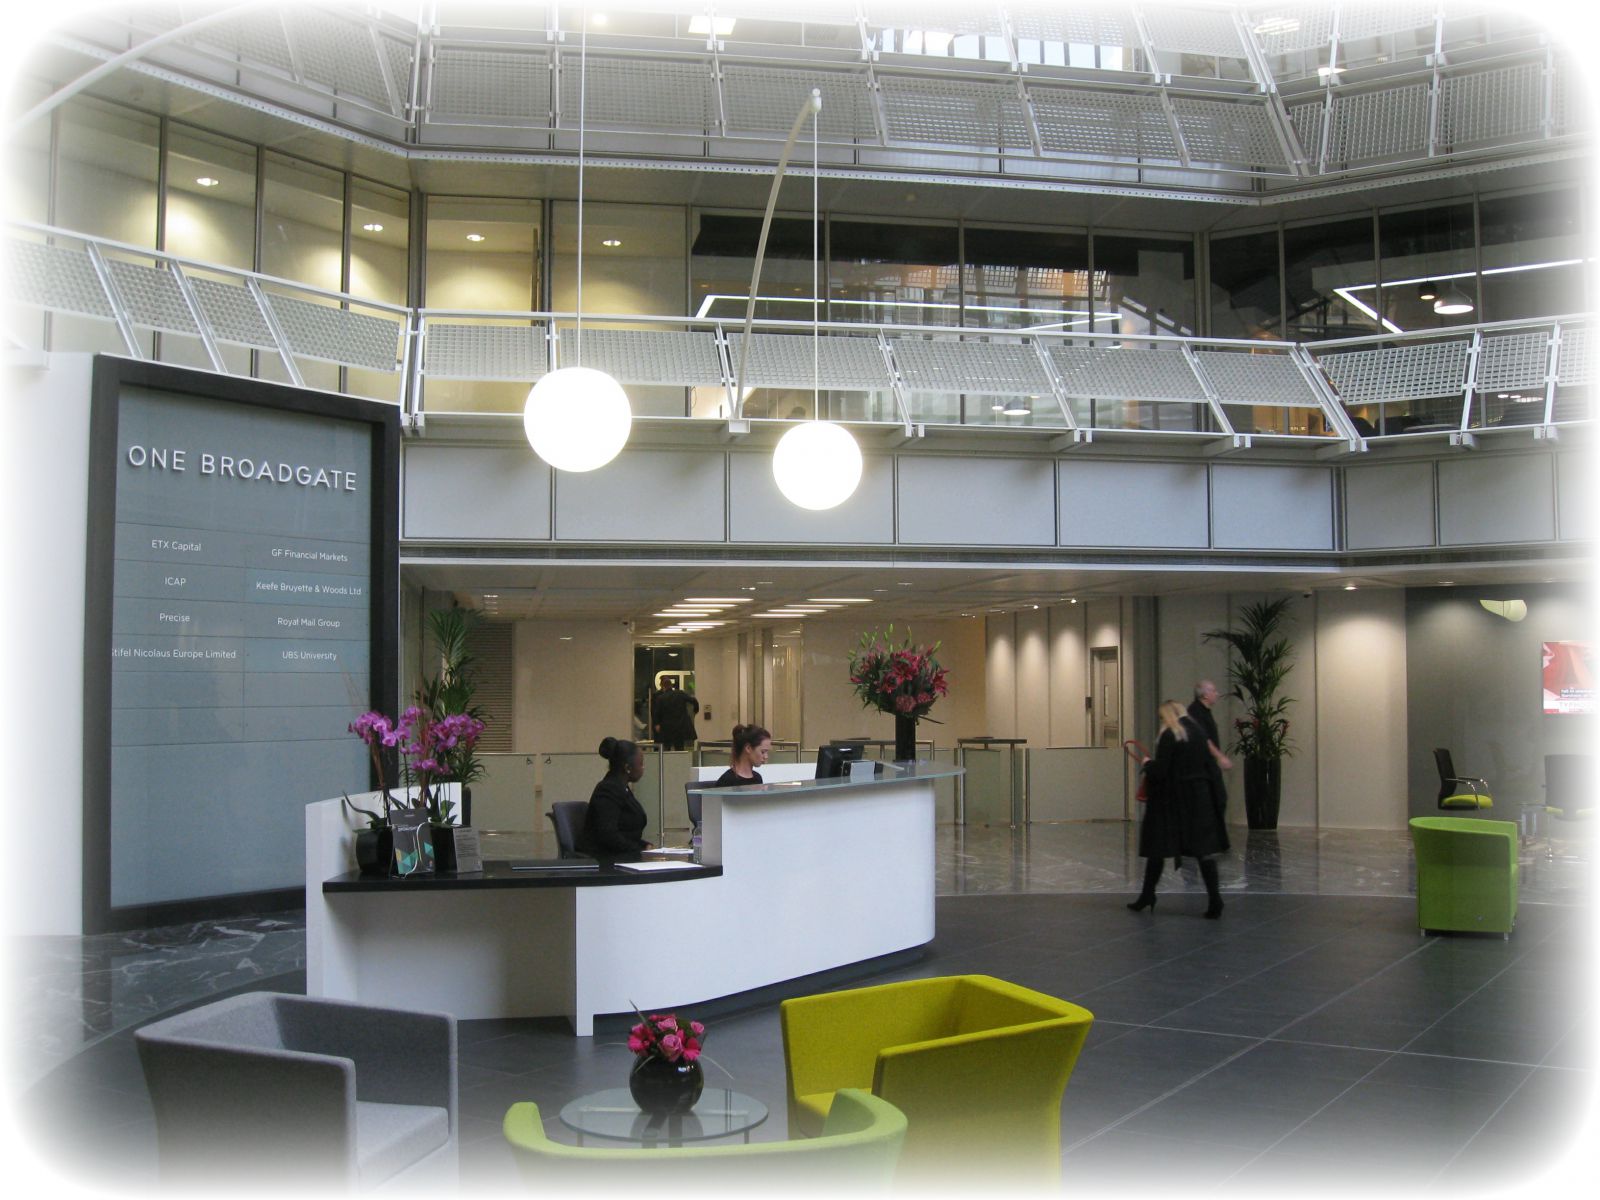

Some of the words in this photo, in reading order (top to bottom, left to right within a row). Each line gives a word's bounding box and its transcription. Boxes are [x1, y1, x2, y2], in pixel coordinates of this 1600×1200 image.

[129, 445, 186, 471] ONE
[201, 453, 357, 491] BROADGATE
[151, 539, 170, 549] ETX
[171, 541, 202, 552] Capital
[271, 548, 283, 557] GF
[284, 549, 318, 560] Financial
[319, 552, 348, 562] Markets
[164, 576, 187, 587] ICAP
[256, 581, 279, 591] Keefe
[280, 582, 313, 593] Bruyette
[314, 584, 321, 593] &
[321, 585, 348, 595] Woods
[349, 587, 362, 595] Ltd
[159, 612, 191, 622] Precise
[277, 617, 299, 627] Royal
[300, 618, 316, 627] Mail
[317, 618, 341, 628] Group
[133, 648, 171, 658] Nicolaus
[172, 649, 204, 660] Europe
[205, 650, 237, 659] Limited
[282, 650, 299, 660] UBS
[300, 651, 338, 661] University
